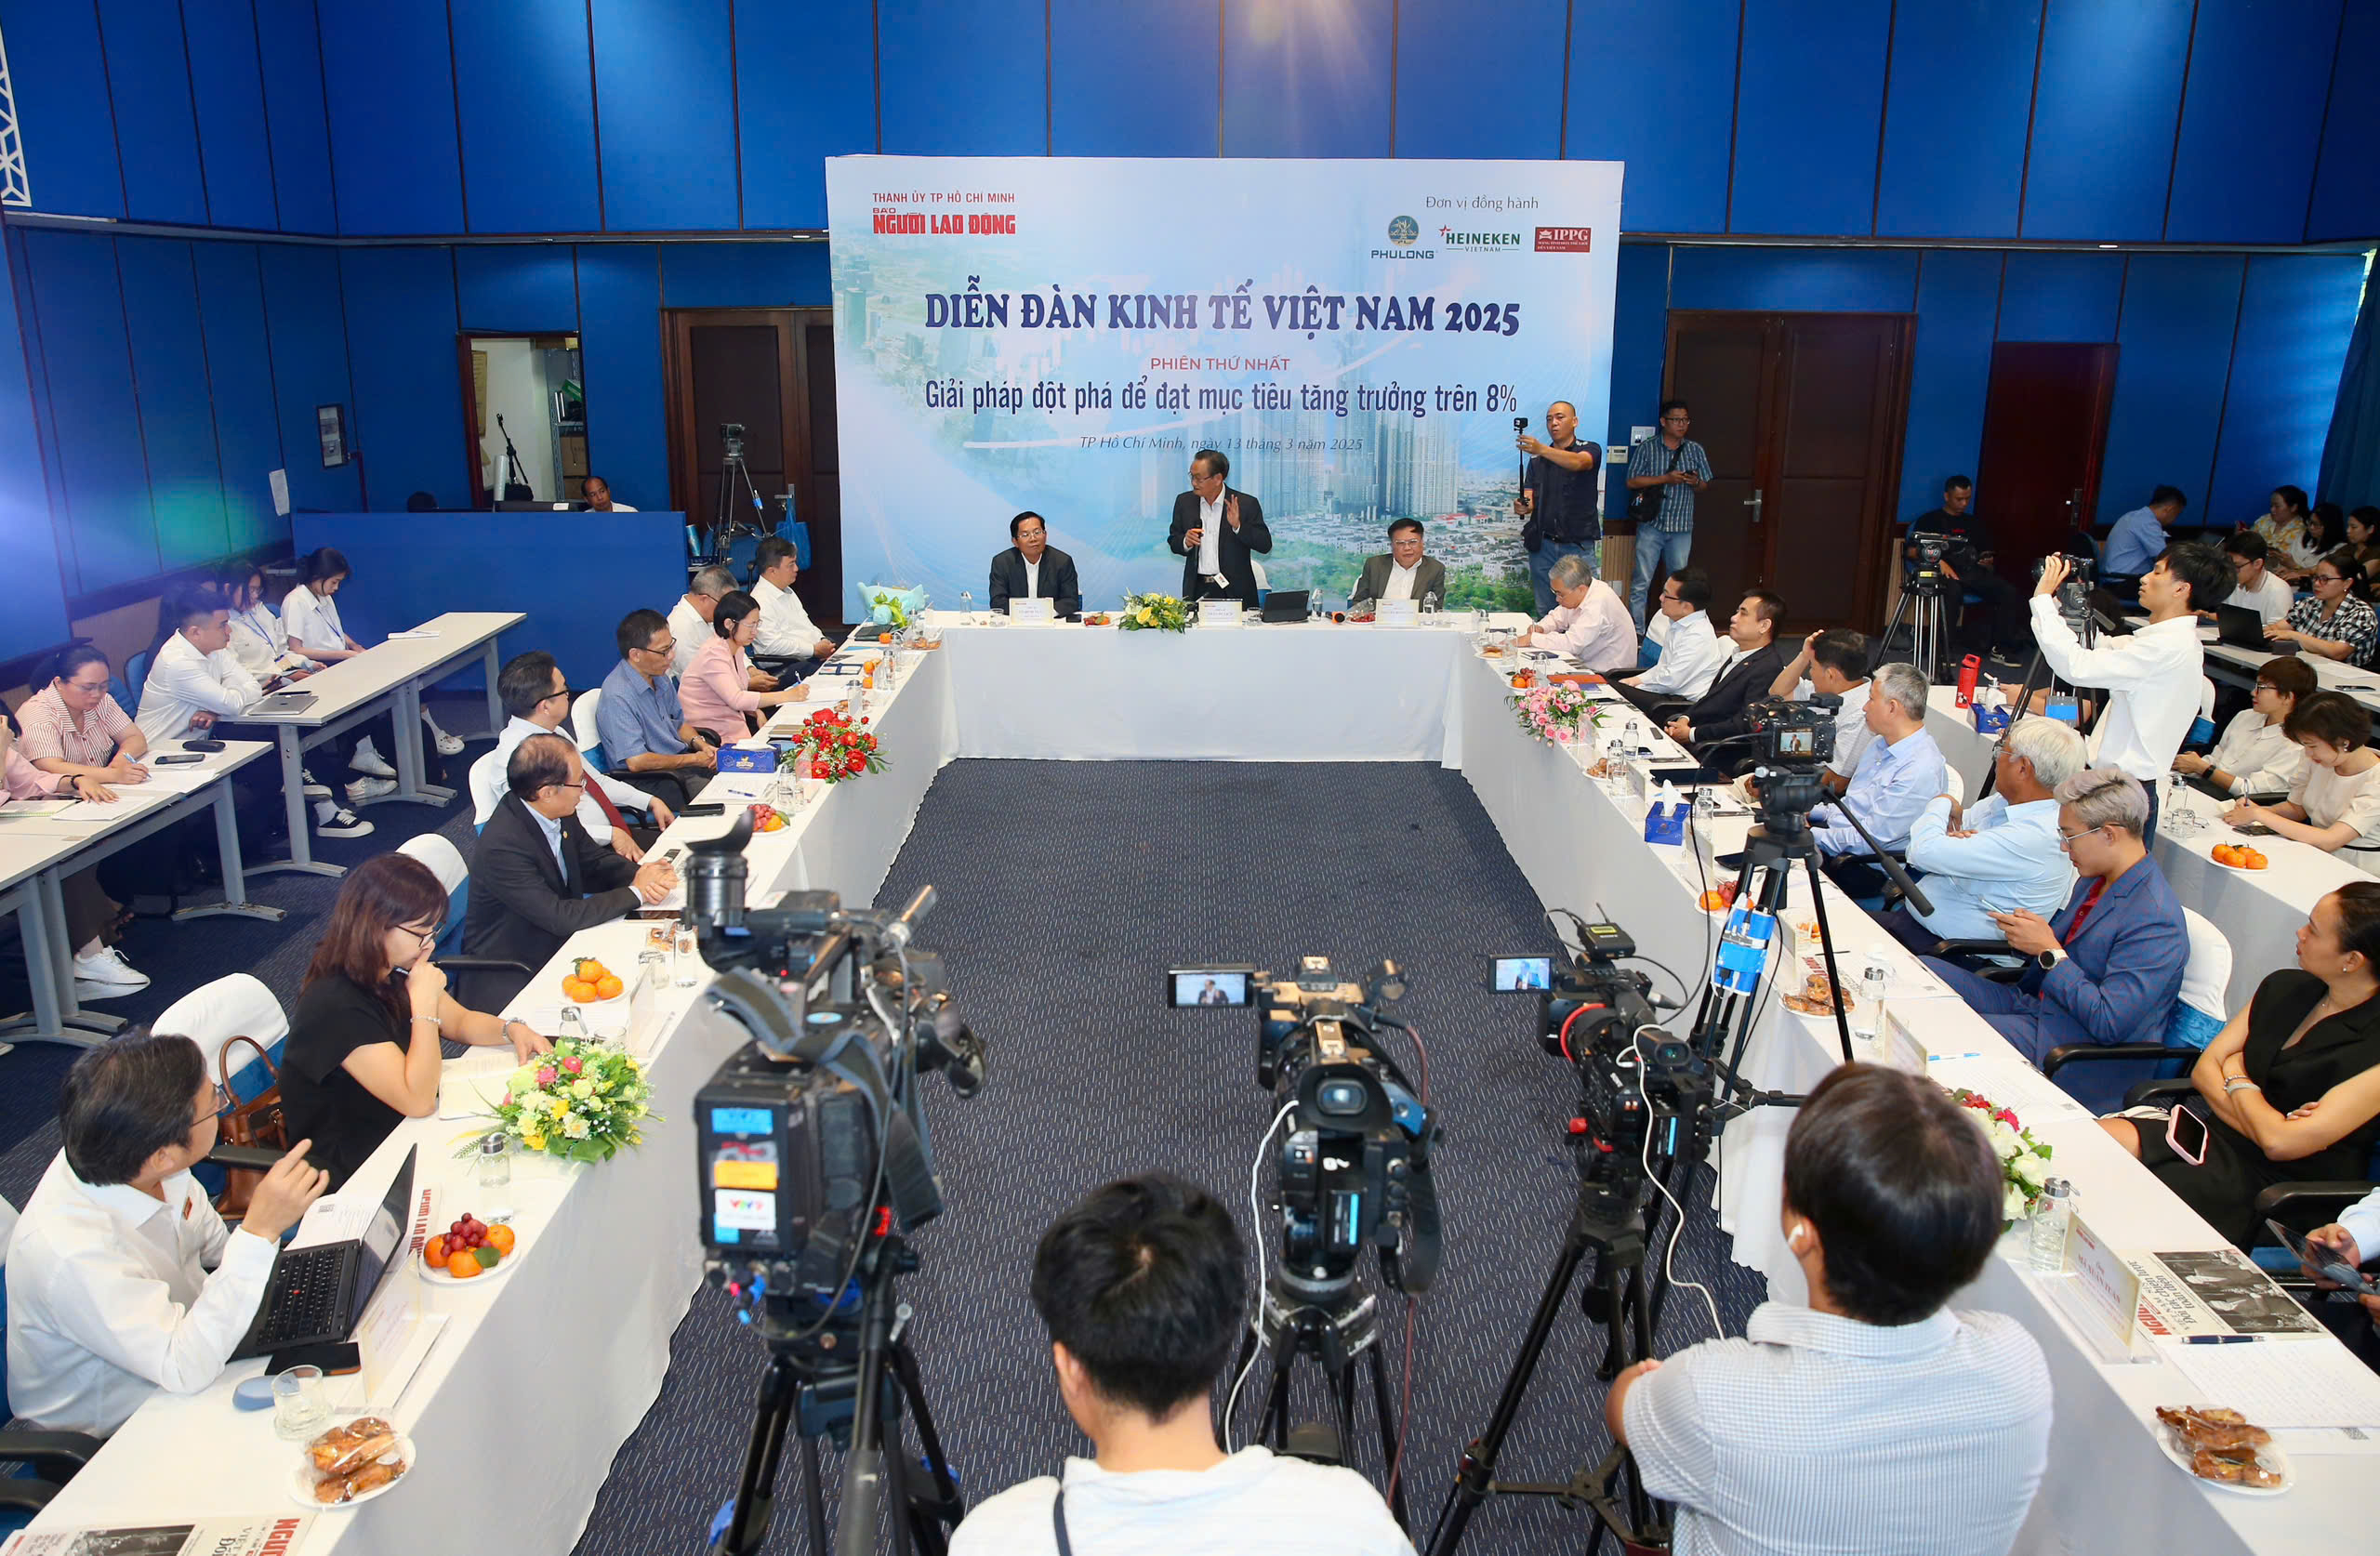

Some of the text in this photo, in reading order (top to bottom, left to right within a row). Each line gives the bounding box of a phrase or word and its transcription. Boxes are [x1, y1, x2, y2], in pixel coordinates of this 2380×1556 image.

[911, 190, 926, 203] ỦY
[930, 192, 944, 203] TP
[946, 190, 961, 203] HỒ
[965, 191, 984, 203] CHÍ
[987, 192, 1015, 203] MINH
[1425, 193, 1540, 212] Đơn vị đồng hành
[873, 212, 1016, 235] NGƯỜI LAO ĐỘNG
[1446, 232, 1521, 245] HEINEKEN
[1554, 229, 1589, 242] IPPG
[1371, 249, 1435, 259] PHULONG
[924, 274, 1521, 340] DIỄN ĐÀN KINH TẾ VIỆT NAM 2025
[1151, 354, 1290, 370] PHIÊN THỨ NHẤT
[925, 375, 1517, 418] Giải pháp đột phá để đạt mục tiêu tăng trưởng trên 8%
[1079, 433, 1364, 453] TP Hồ Chí Minh, ngày 13 tháng 3 năm 2025
